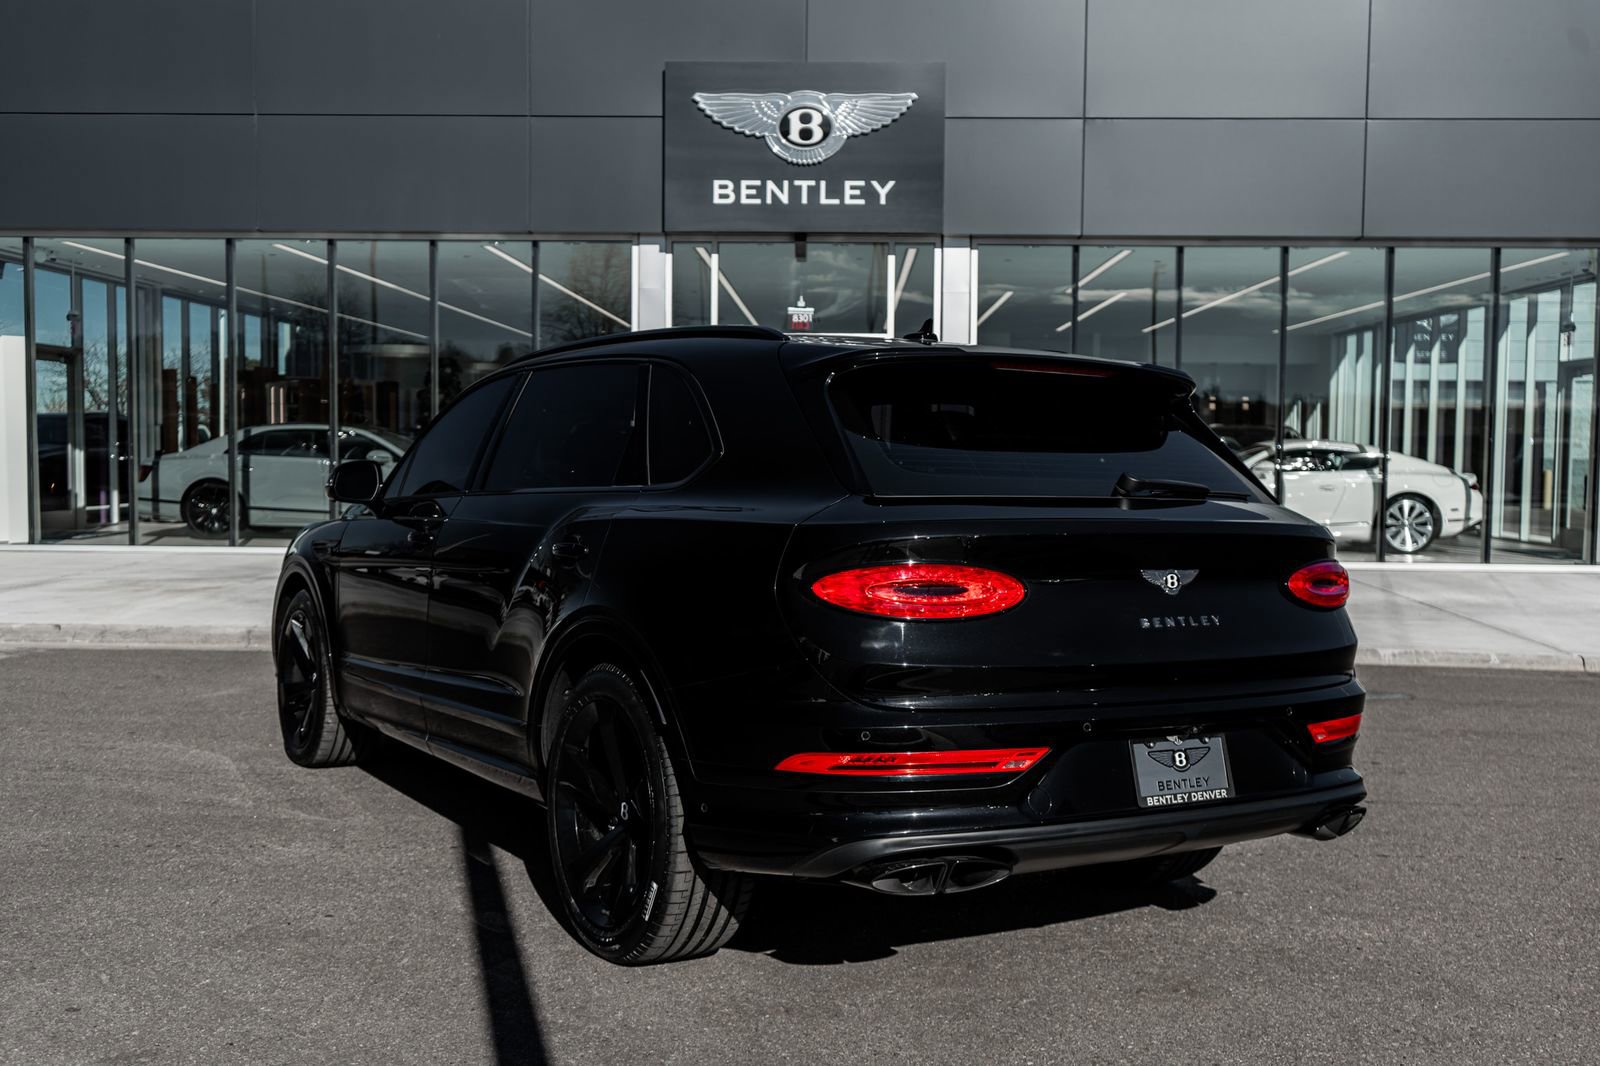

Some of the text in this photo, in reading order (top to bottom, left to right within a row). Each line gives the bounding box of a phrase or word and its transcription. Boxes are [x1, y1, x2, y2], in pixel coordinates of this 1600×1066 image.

[787, 109, 824, 146] B
[712, 179, 896, 205] BENTLEY
[1166, 573, 1178, 589] B
[1140, 615, 1220, 628] BENTLEY
[1174, 751, 1187, 767] B
[1157, 776, 1210, 792] BENTLEY
[1146, 789, 1228, 806] BENTLEY DENVER
